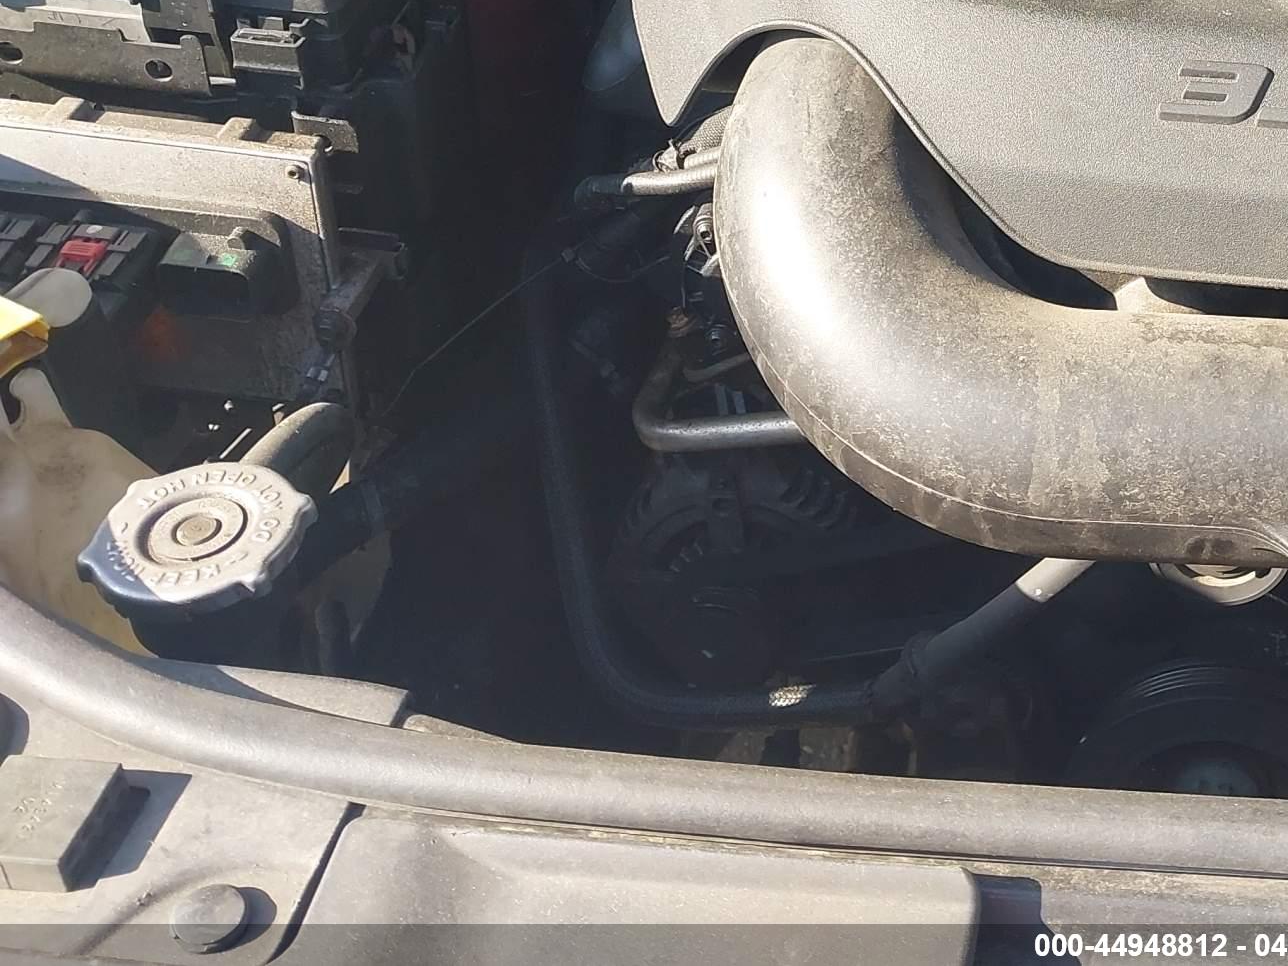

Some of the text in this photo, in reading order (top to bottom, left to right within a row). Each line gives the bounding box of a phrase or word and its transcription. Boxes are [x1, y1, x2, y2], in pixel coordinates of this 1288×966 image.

[190, 469, 257, 487] OPEN
[136, 477, 186, 511] HOT
[250, 518, 281, 544] DO
[149, 562, 221, 587] KEEP
